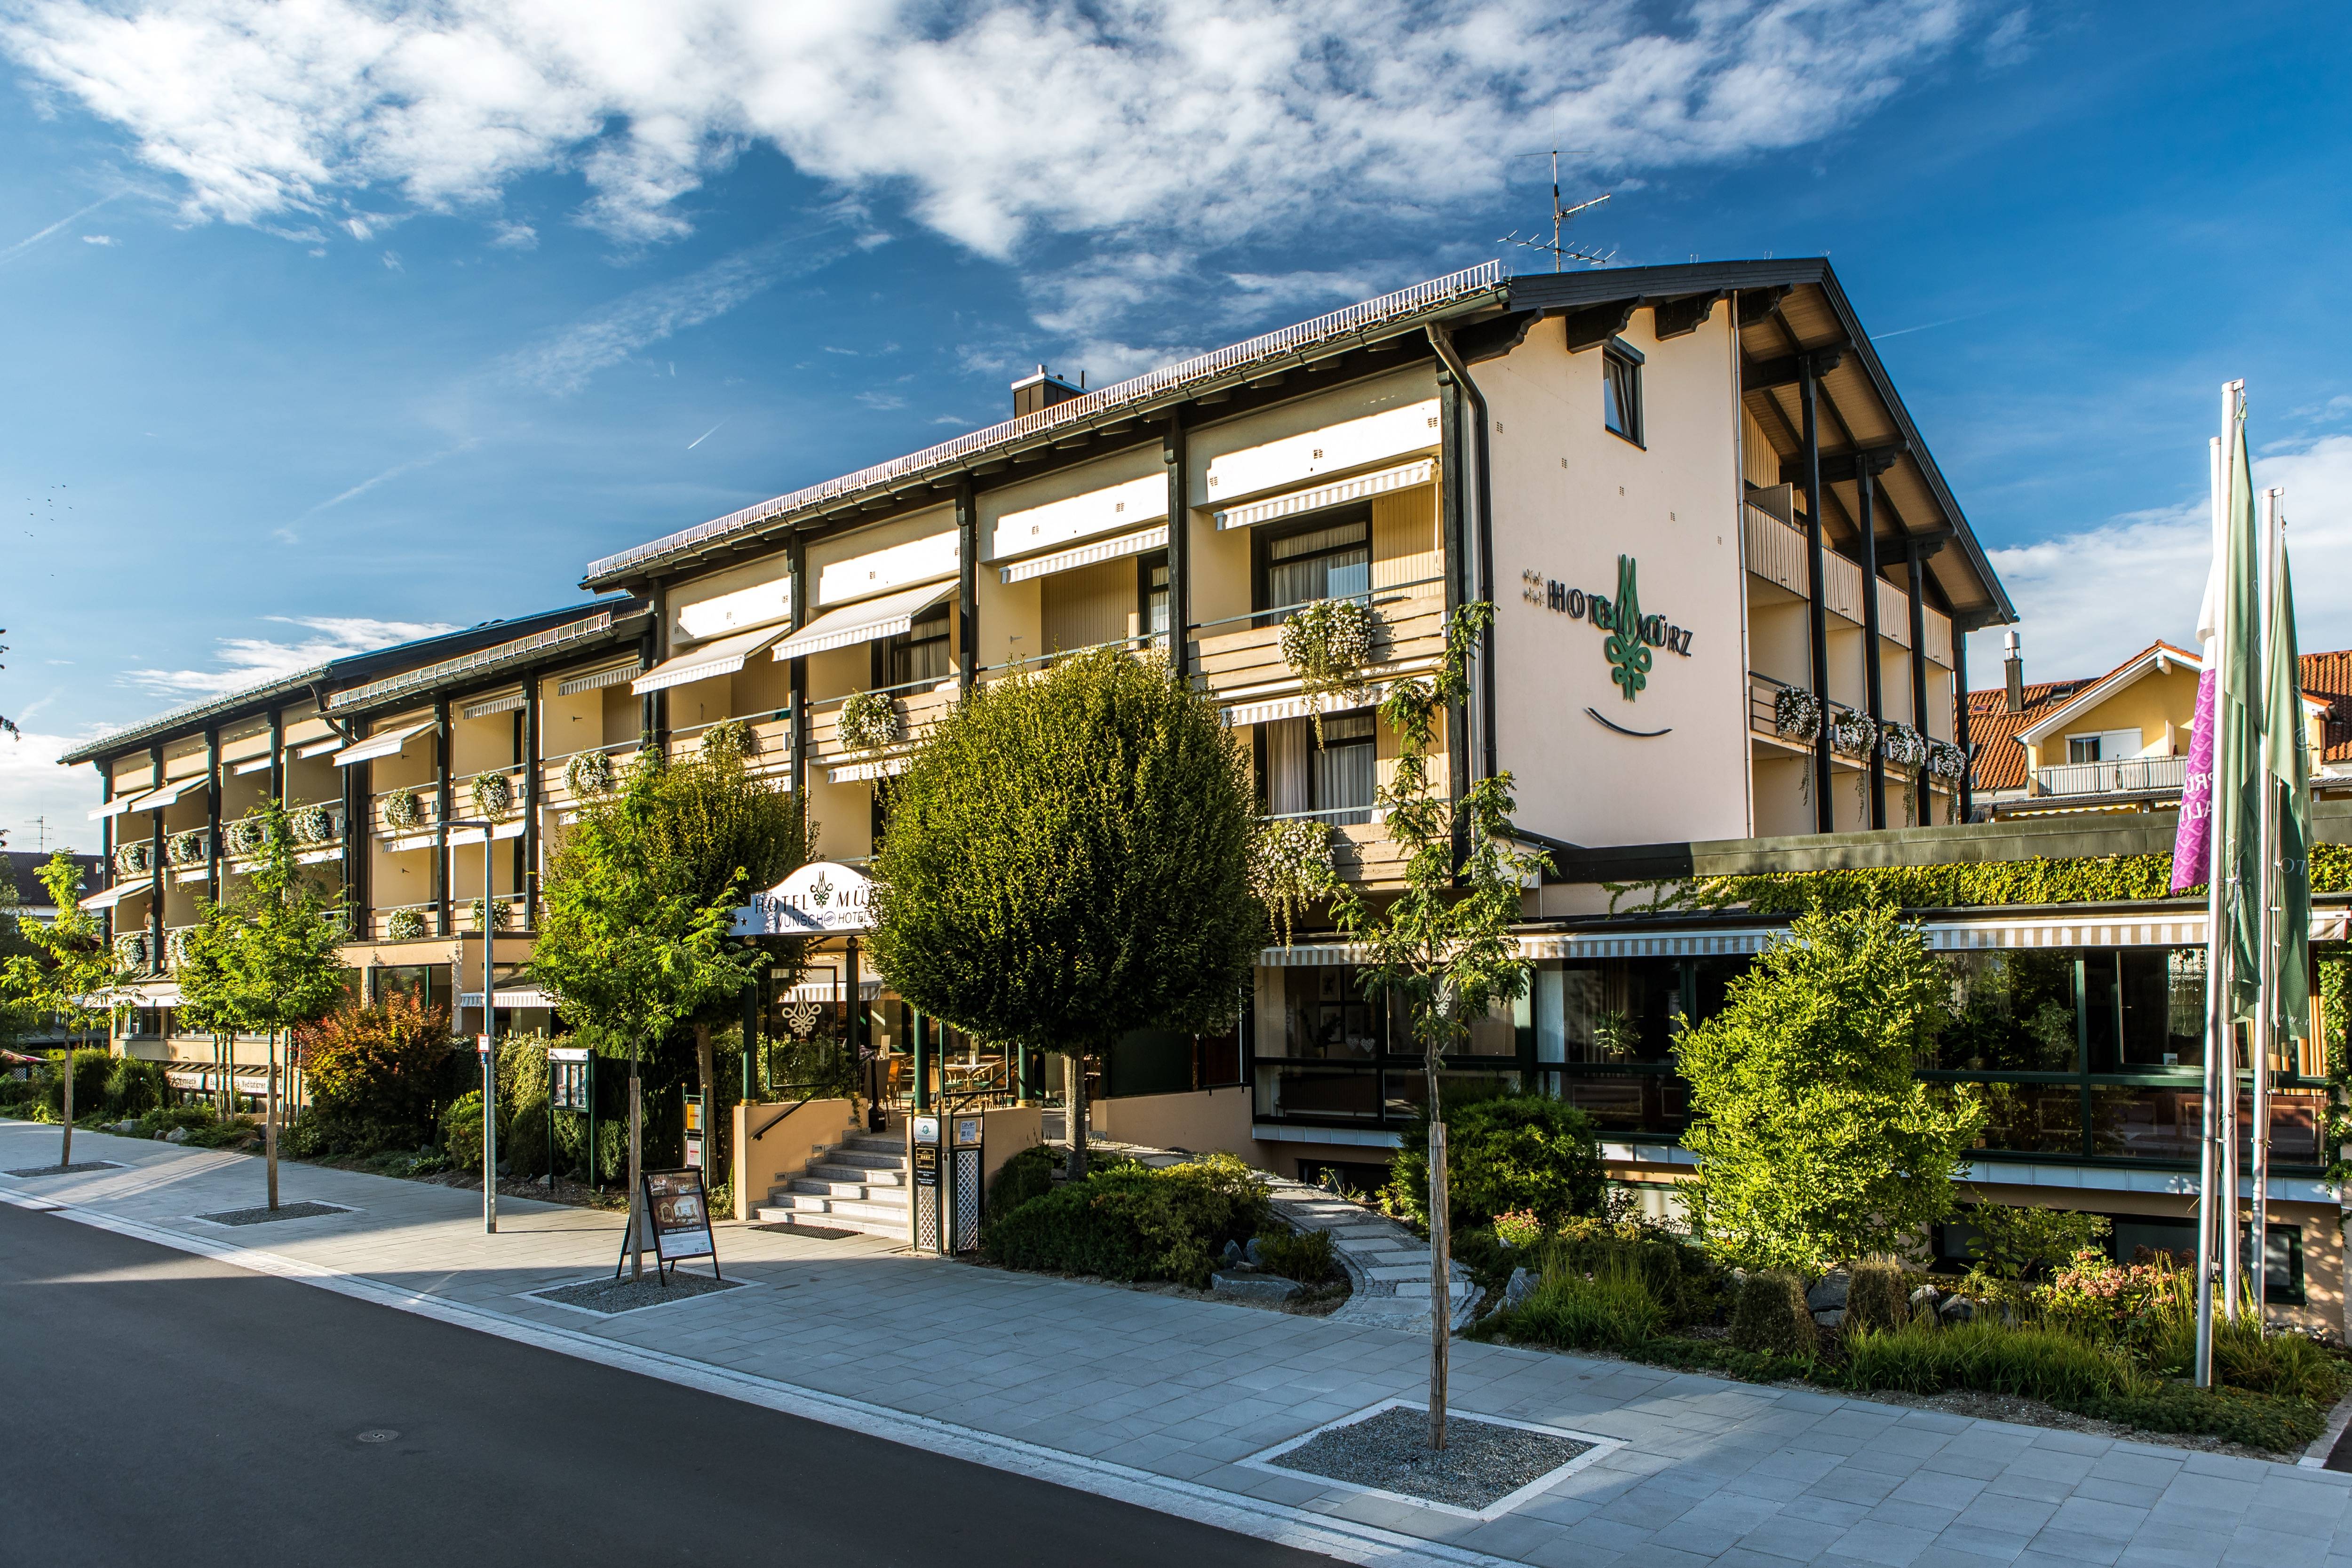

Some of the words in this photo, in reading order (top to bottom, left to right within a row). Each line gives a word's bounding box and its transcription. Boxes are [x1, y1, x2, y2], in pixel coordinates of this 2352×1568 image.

[1551, 579, 1624, 635] HOTEL
[1637, 613, 1693, 657] MÜRZ
[755, 894, 808, 914] HOTEL
[837, 885, 865, 907] MÜ
[774, 914, 823, 928] WUNSCH
[839, 911, 868, 923] HOTEL
